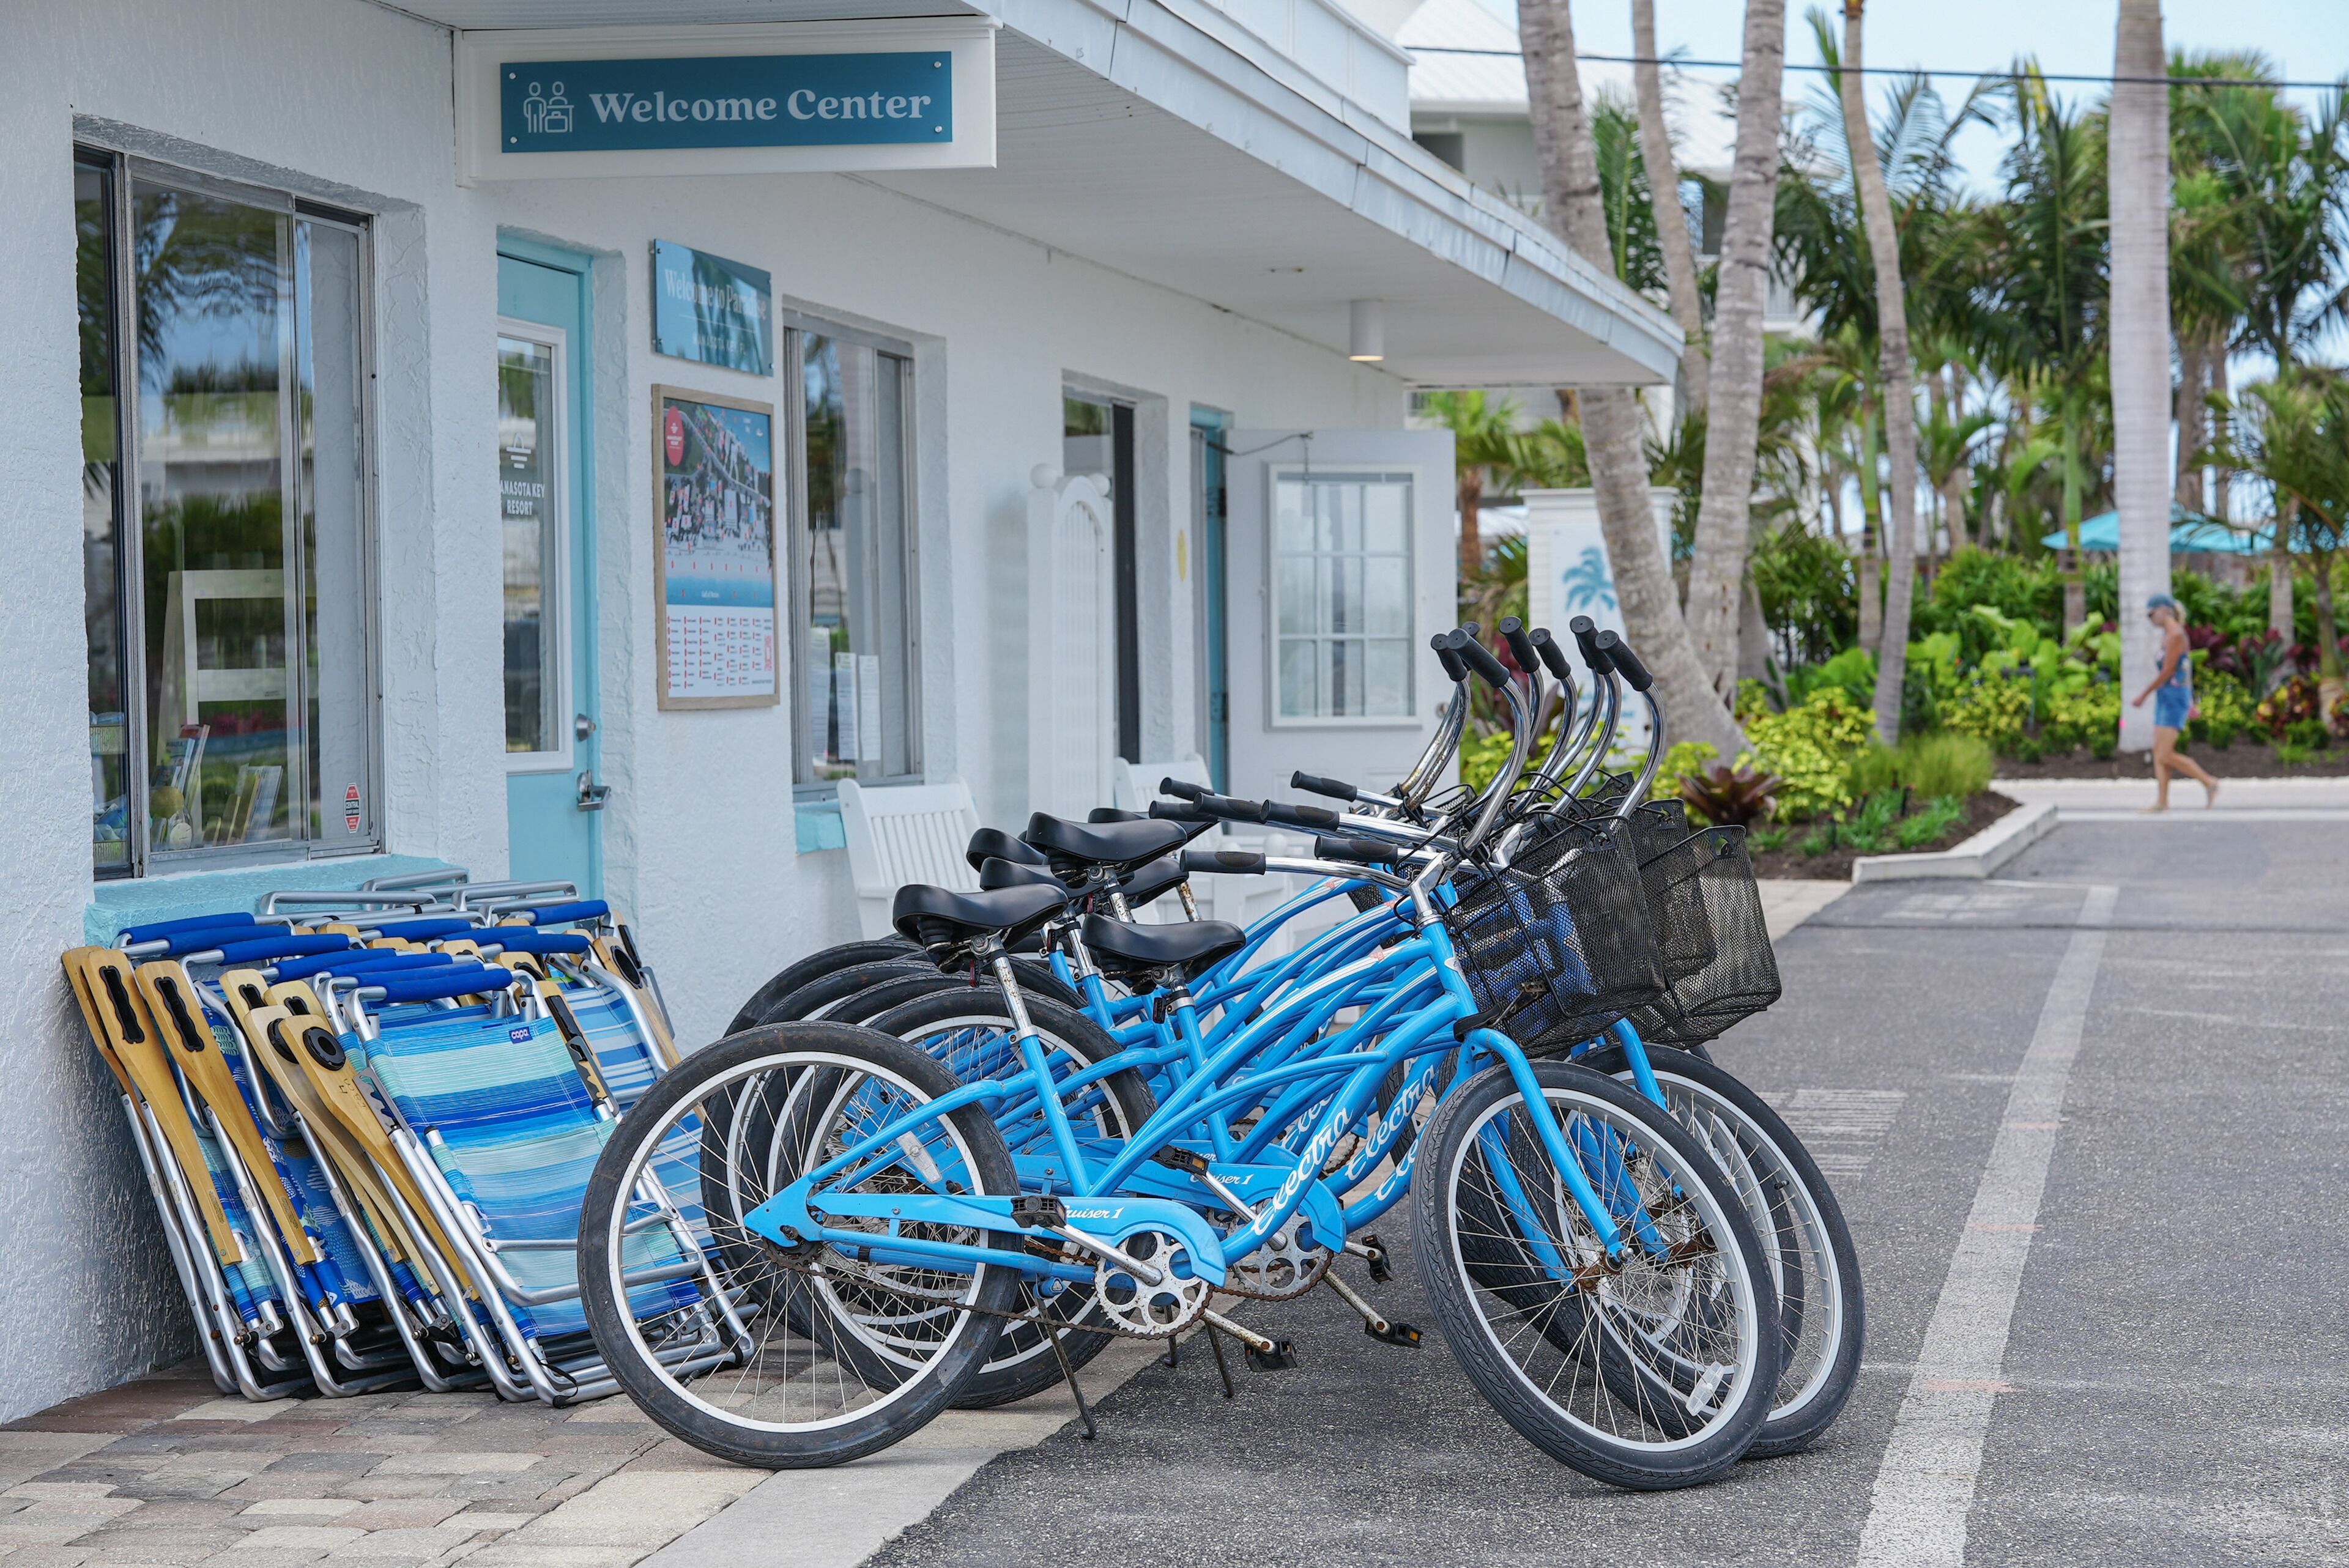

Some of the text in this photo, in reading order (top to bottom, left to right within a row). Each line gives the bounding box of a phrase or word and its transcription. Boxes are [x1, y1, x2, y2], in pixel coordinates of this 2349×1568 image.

[588, 89, 931, 123] Welcome Center
[664, 268, 766, 320] Welcome to Paradise
[499, 479, 546, 498] ANASOTA KEY
[507, 499, 533, 516] RESORT
[511, 1029, 529, 1040] copa
[1345, 1064, 1436, 1181] Electra
[1241, 1174, 1254, 1185] 1
[1250, 1108, 1354, 1236] Electra
[1111, 1207, 1125, 1219] 1
